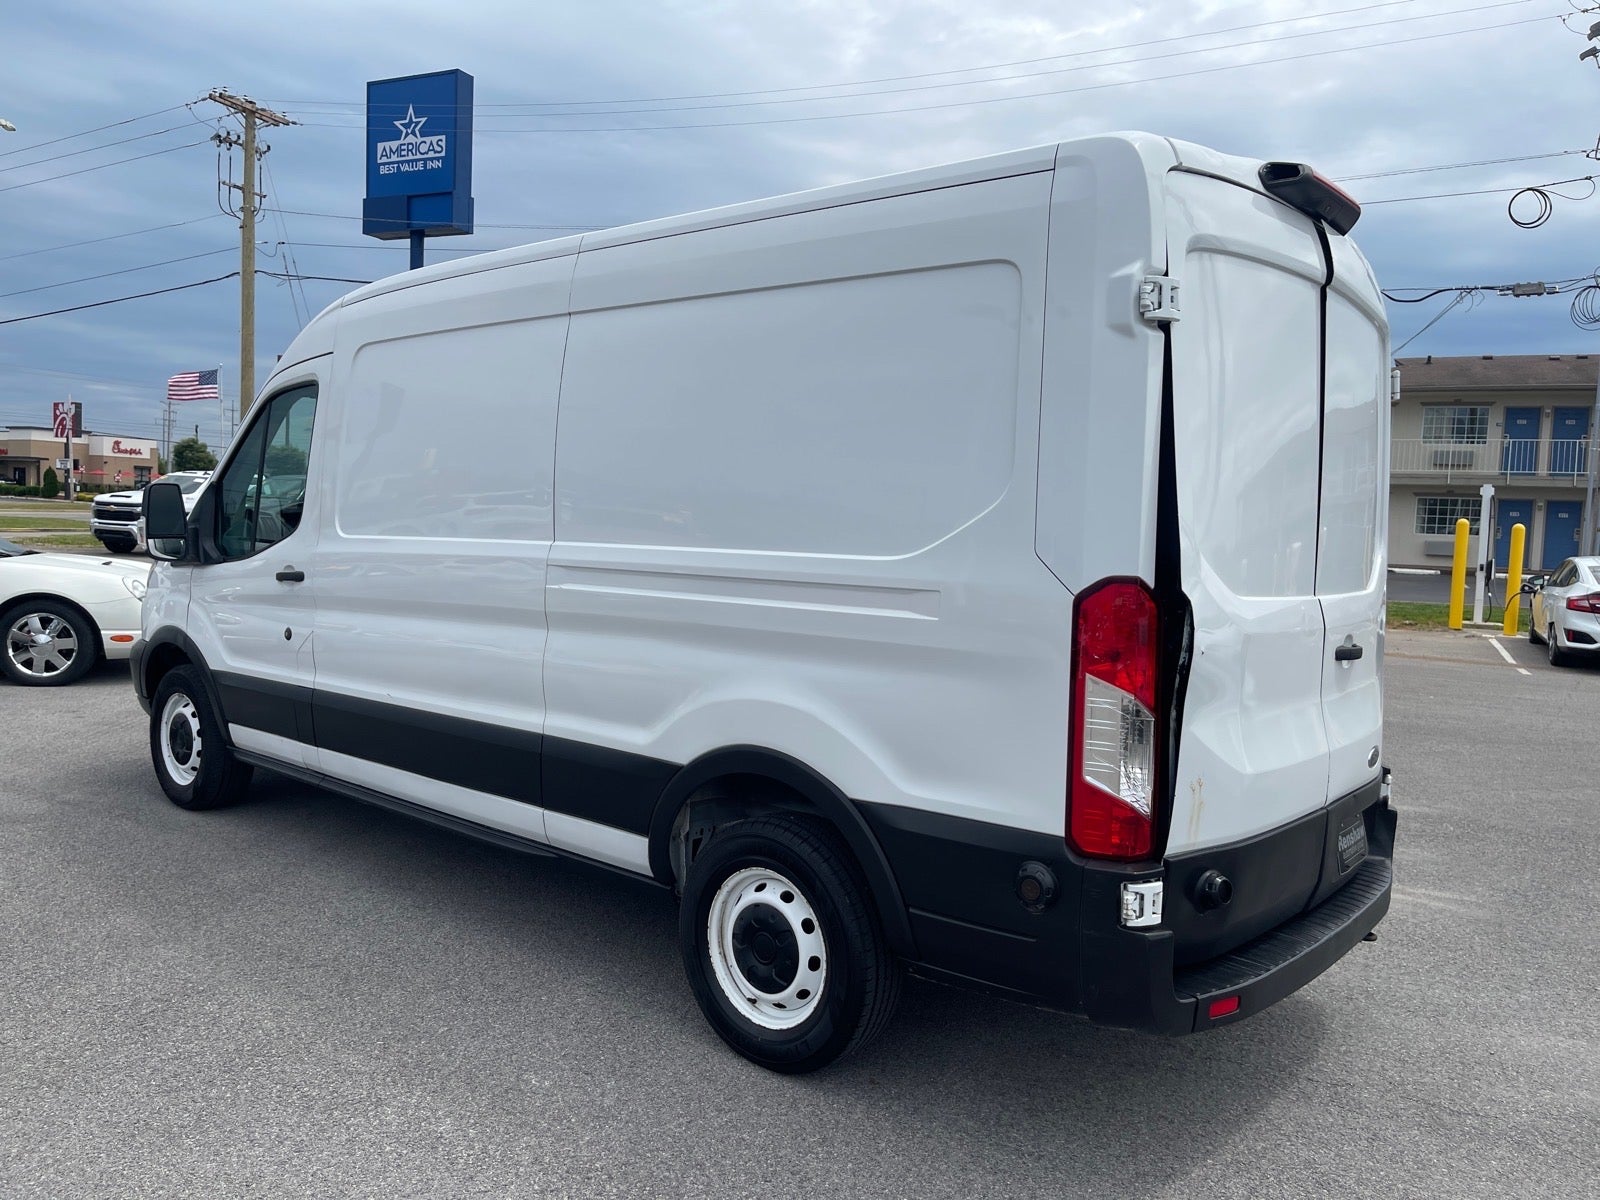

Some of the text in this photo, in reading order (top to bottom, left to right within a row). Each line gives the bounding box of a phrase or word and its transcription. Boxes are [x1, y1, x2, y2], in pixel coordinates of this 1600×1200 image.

[379, 139, 444, 160] AMERICAS
[380, 159, 442, 174] BEST VALUE INN
